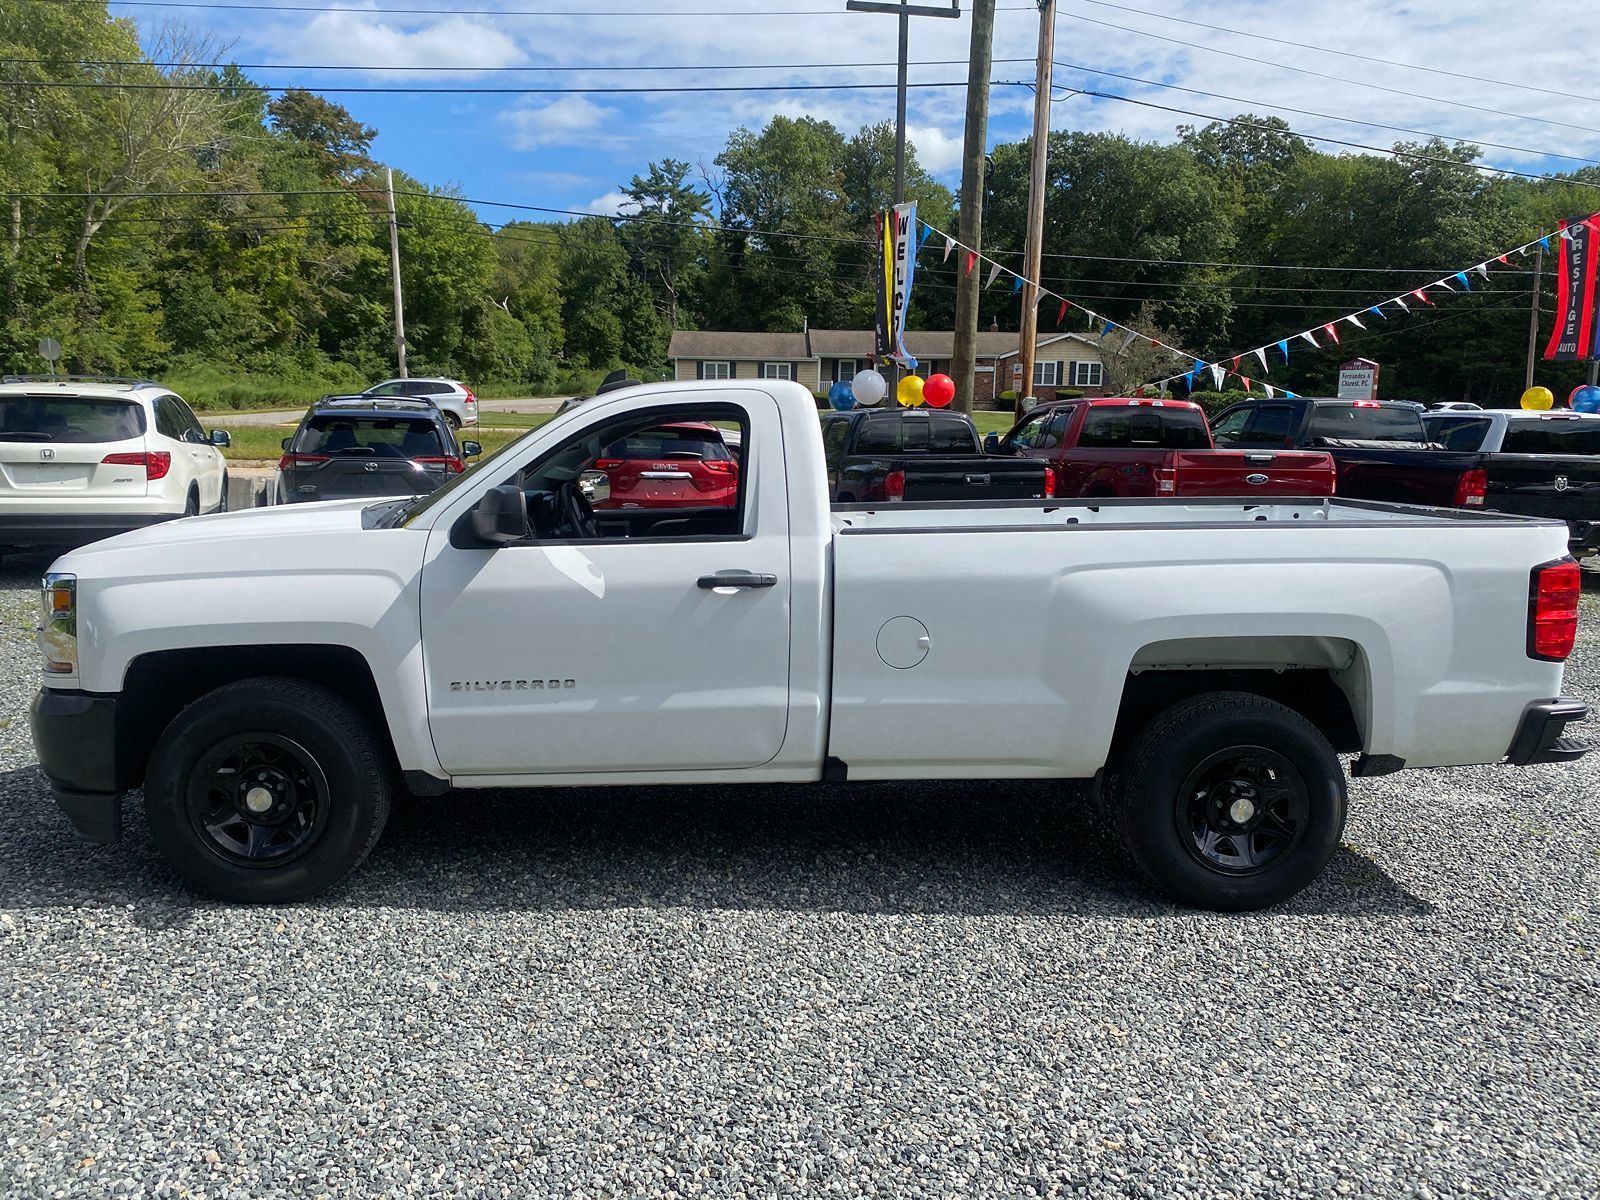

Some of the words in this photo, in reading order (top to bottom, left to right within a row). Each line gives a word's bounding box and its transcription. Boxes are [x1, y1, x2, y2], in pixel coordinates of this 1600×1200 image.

[1566, 224, 1584, 335] PRESTIGE
[1557, 342, 1576, 353] AUTO
[449, 678, 576, 692] SILVERADO
